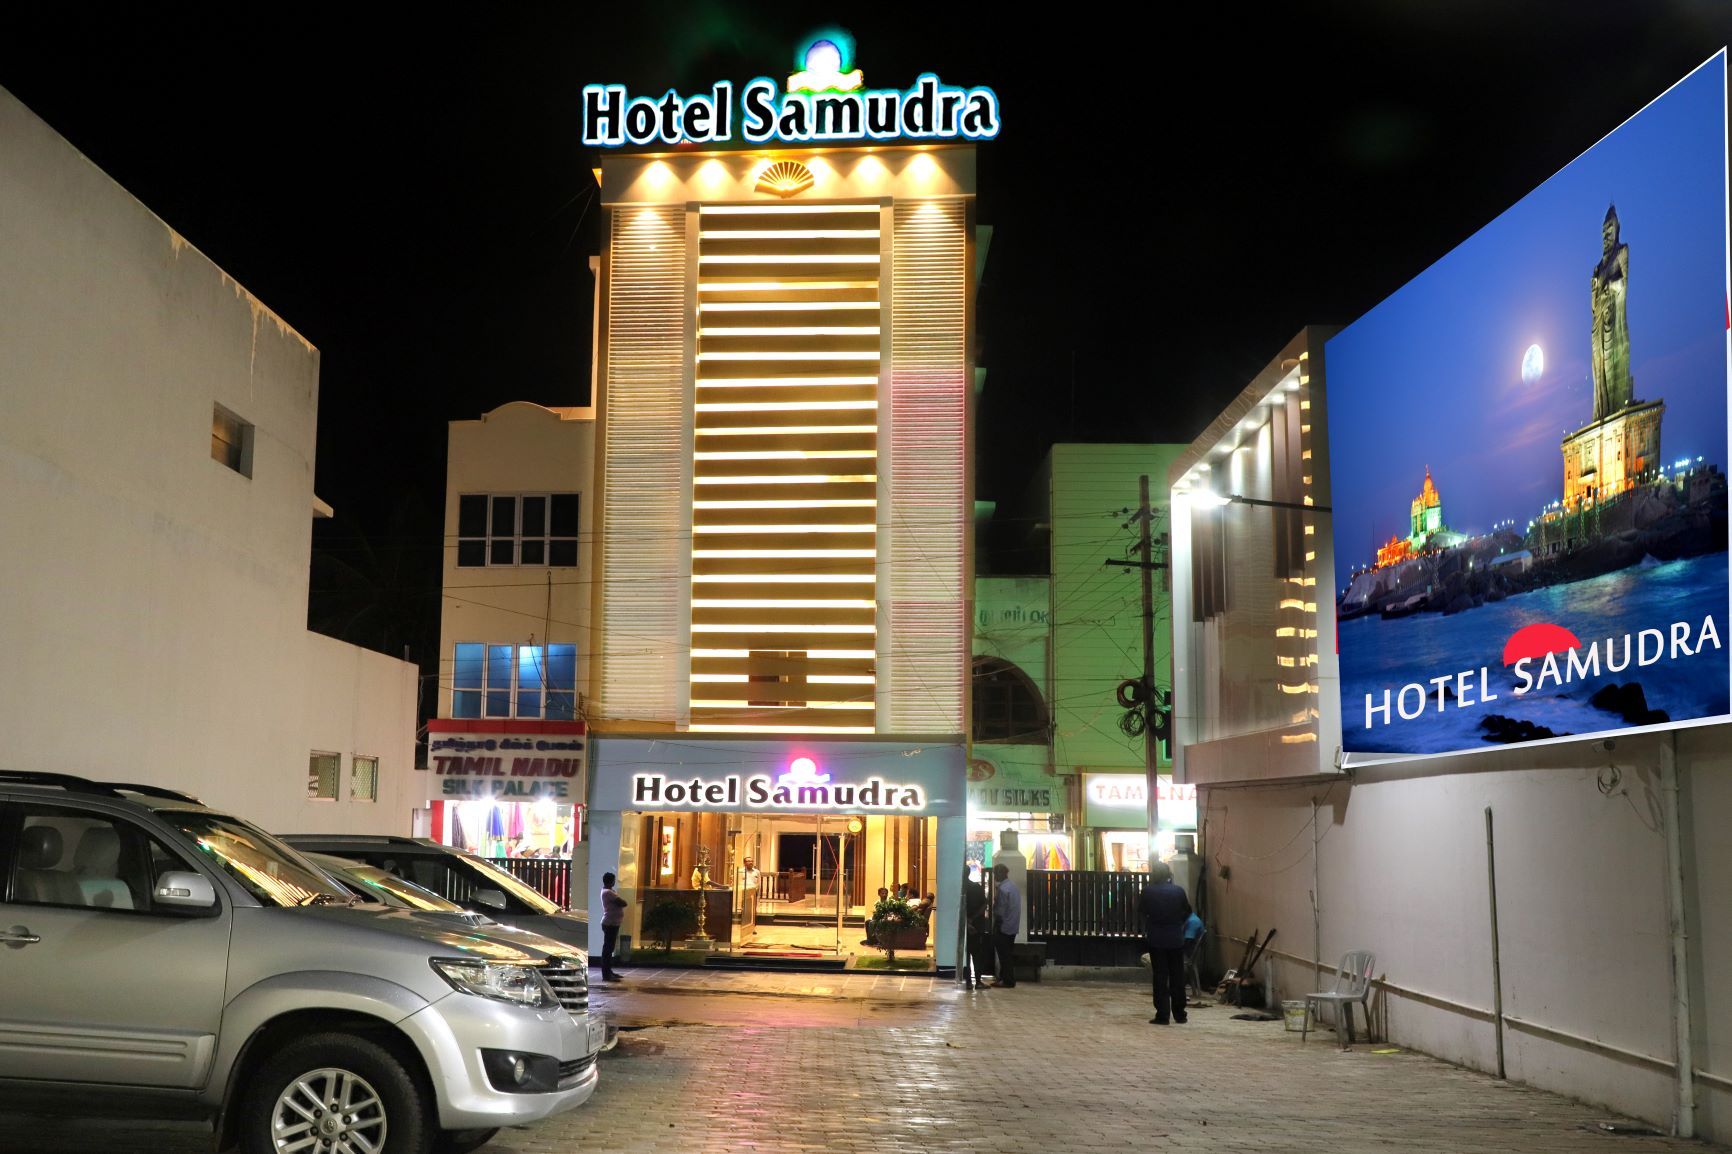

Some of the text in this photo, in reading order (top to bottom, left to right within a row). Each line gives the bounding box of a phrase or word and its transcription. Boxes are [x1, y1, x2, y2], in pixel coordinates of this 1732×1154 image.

[585, 79, 997, 142] Hotel Samudra
[1365, 614, 1722, 729] HOTEL SAMUDRA
[432, 755, 581, 778] TAMIL NADU
[442, 778, 569, 797] SILK PALACE
[635, 776, 922, 807] Hotel Samudra
[1003, 789, 1050, 807] SILKS
